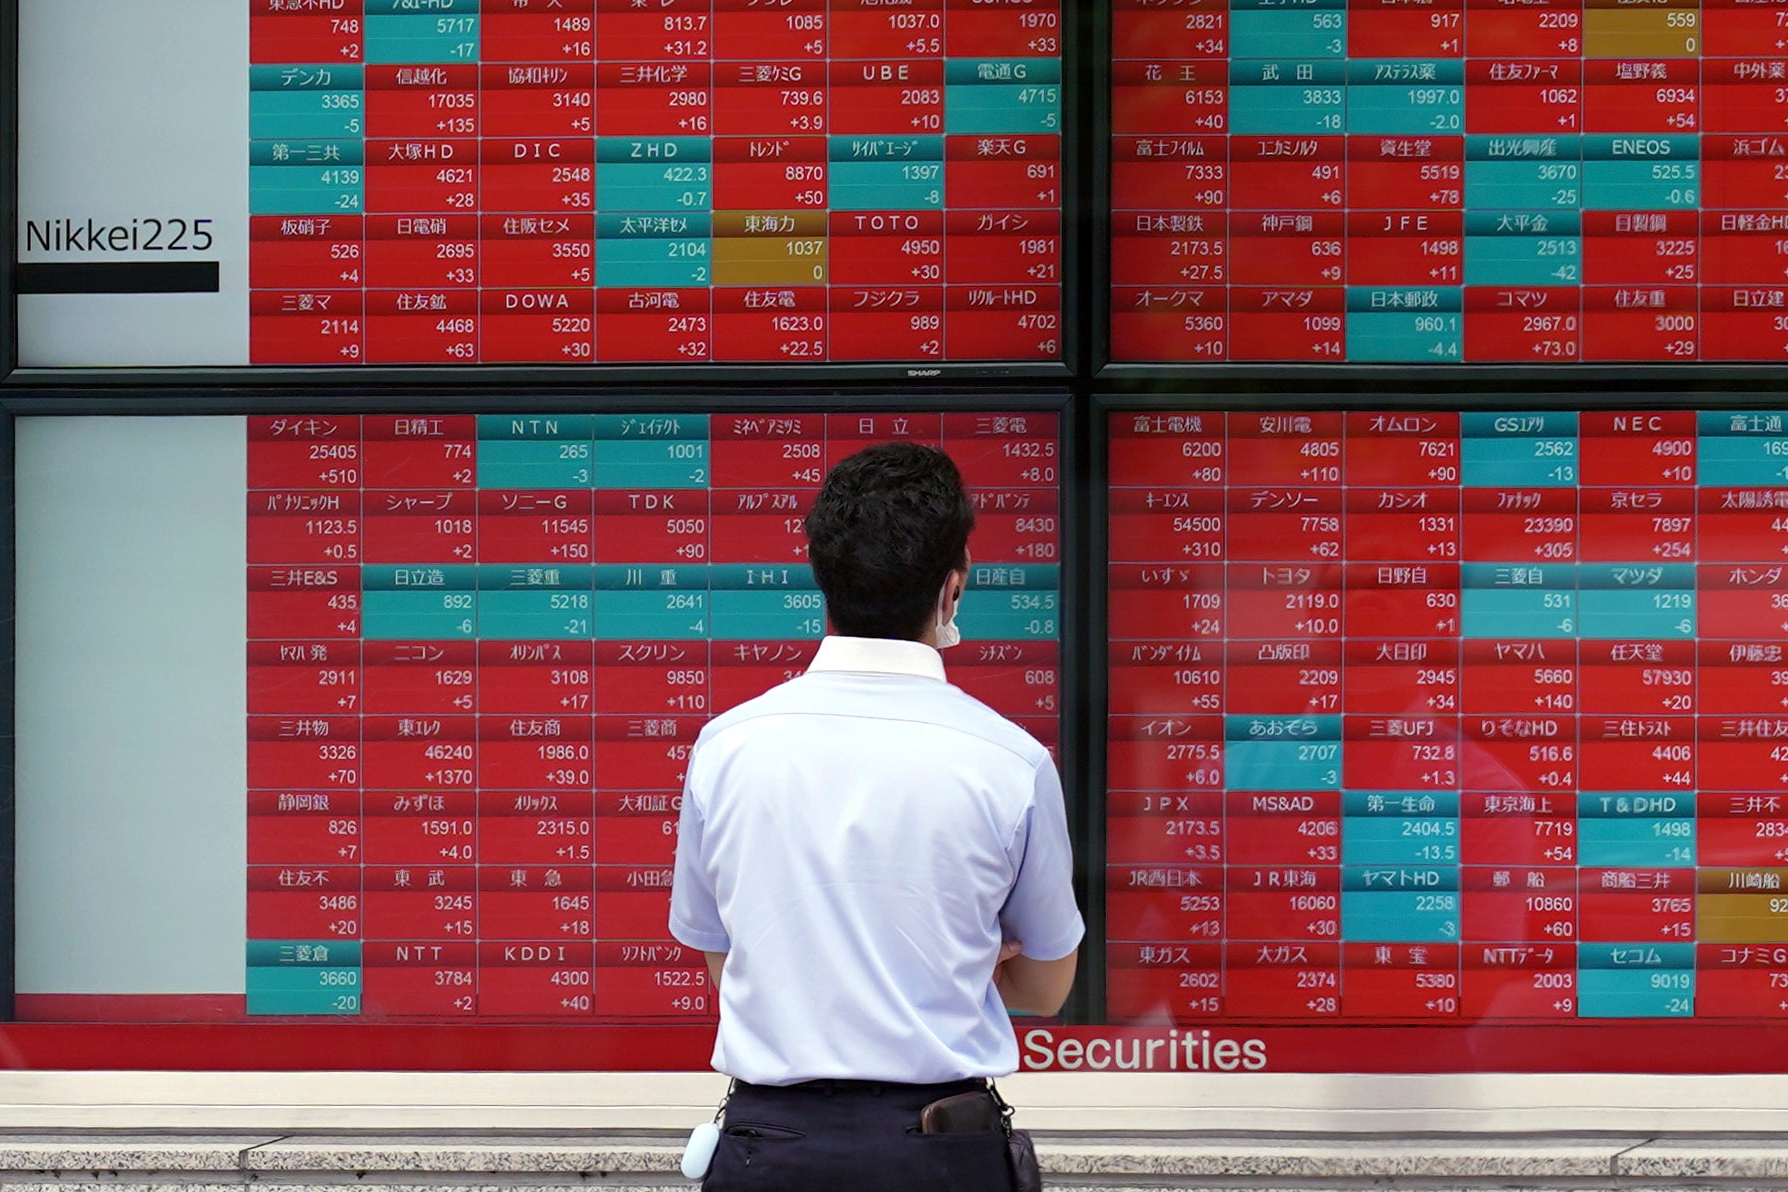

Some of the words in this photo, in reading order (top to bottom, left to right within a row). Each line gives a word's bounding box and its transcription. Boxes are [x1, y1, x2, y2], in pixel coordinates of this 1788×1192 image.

[281, 67, 331, 86] デンカ
[620, 64, 688, 83] 三井化学
[977, 63, 1027, 80] 電通G
[1615, 62, 1668, 80] 塩野義
[321, 94, 360, 109] 3365
[668, 91, 707, 106] 2980
[1018, 88, 1057, 104] 4715
[1656, 88, 1695, 103] 6934
[344, 118, 360, 134] -5
[678, 115, 707, 131] +16
[1040, 112, 1057, 128] -5
[1666, 112, 1696, 129] +54
[272, 143, 340, 161] 第一三共
[977, 138, 1026, 156] 楽天G
[1380, 139, 1432, 157] 資生堂
[1612, 139, 1671, 155] ENEOS
[320, 169, 360, 185] 4139
[1027, 164, 1054, 179] 691
[1420, 164, 1460, 180] 5519
[1652, 164, 1696, 180] 525.5
[334, 194, 359, 209] -24
[1036, 188, 1055, 203] +1
[1429, 189, 1460, 205] +78
[1665, 188, 1696, 205] -0.6
[280, 218, 332, 236] 板硝子
[503, 217, 570, 235] 住阪セメ
[977, 213, 1029, 231] ガイシ
[1137, 214, 1204, 232] 日本製鉄
[1261, 214, 1313, 232] 神戸鋼
[26, 216, 214, 252] Nikkei225
[330, 244, 360, 259] 526
[552, 242, 591, 258] 3550
[1019, 239, 1054, 255] 1981
[1170, 240, 1223, 256] 2173.5
[1311, 240, 1342, 256] 636
[339, 268, 359, 283] +4
[571, 267, 591, 282] +5
[1027, 263, 1054, 279] +21
[1179, 264, 1223, 280] +27.5
[1321, 265, 1342, 281] +9
[282, 293, 332, 311] 三菱マ
[396, 293, 447, 310] 住友鉱
[628, 291, 680, 309] 古河電
[854, 290, 920, 307] フジクラ
[1135, 290, 1204, 307] オークマ
[1262, 290, 1314, 307] アマダ
[1371, 290, 1438, 308] 日本郵政
[1498, 291, 1548, 308] コマツ
[320, 319, 359, 335] 2114
[435, 318, 475, 333] 4468
[668, 316, 707, 332] 2473
[910, 315, 940, 331] 989
[1184, 315, 1223, 331] 5360
[1303, 316, 1341, 331] 1099
[1414, 316, 1456, 332] 960.1
[1523, 315, 1577, 332] 2967.0
[339, 344, 360, 359] +9
[445, 342, 474, 358] +63
[677, 341, 706, 356] +32
[920, 339, 939, 355] +2
[1194, 340, 1223, 356] +10
[1311, 341, 1341, 356] +14
[1427, 341, 1458, 357] -4.4
[1532, 340, 1577, 356] +73.0
[270, 418, 338, 436] ダイキン
[1369, 415, 1437, 433] オムロン
[309, 444, 357, 460] 25405
[1419, 441, 1454, 457] 7621
[318, 469, 357, 484] +510
[1428, 466, 1456, 481] +90
[386, 492, 453, 511] シャープ
[502, 494, 567, 510] ソニーG
[1251, 490, 1318, 508] デンソー
[1378, 491, 1428, 508] カシオ
[1610, 491, 1663, 509] 京セラ
[434, 519, 473, 534] 1018
[541, 518, 588, 534] 11545
[1300, 516, 1340, 532] 7758
[1419, 516, 1454, 532] 1331
[1652, 517, 1692, 533] 7897
[452, 543, 473, 559] +2
[550, 543, 589, 559] +150
[1309, 541, 1339, 557] +62
[1427, 541, 1457, 557] +13
[1652, 541, 1692, 558] +254
[395, 568, 445, 586] 日立造
[510, 568, 560, 586] 三菱重
[1263, 567, 1311, 585] トヨタ
[443, 594, 473, 609] 892
[550, 594, 589, 609] 5218
[1285, 593, 1339, 609] 2119.0
[456, 618, 473, 634] -6
[563, 618, 587, 635] -21
[1294, 618, 1339, 634] +10.0
[394, 645, 444, 661] ニコン
[1610, 643, 1663, 661] 任天堂
[435, 670, 473, 685] 1629
[1642, 669, 1692, 686] 57930
[452, 694, 473, 710] +5
[1662, 694, 1692, 710] +20
[280, 719, 329, 737] 三井物
[509, 718, 561, 737] 住友商
[1140, 718, 1192, 736] イオン
[1371, 719, 1434, 736] 三菱UFJ
[319, 745, 357, 760] 3326
[538, 744, 589, 760] 1986.0
[1167, 744, 1220, 761] 2775.5
[1412, 744, 1455, 761] 732.8
[328, 769, 357, 784] +70
[546, 769, 589, 785] +39.0
[1186, 768, 1220, 786] +6.0
[1420, 770, 1456, 786] +1.3
[278, 793, 330, 811] 静岡銀
[393, 793, 445, 812] みずほ
[1252, 796, 1314, 811] MS&AD
[1484, 795, 1552, 813] 東京海上
[328, 819, 357, 835] 826
[421, 820, 473, 835] 1591.0
[1297, 820, 1339, 836] 4206
[1534, 821, 1573, 837] 7719
[337, 844, 357, 860] +7
[439, 844, 473, 860] +4.0
[1307, 845, 1338, 861] +33
[1543, 846, 1573, 861] +54
[278, 869, 329, 887] 住友不
[319, 895, 357, 910] 3486
[328, 919, 357, 935] +20
[505, 946, 565, 961] KDDI
[1139, 946, 1190, 964] 東ガス
[1257, 945, 1308, 963] 大ガス
[1610, 947, 1662, 964] セコム
[550, 970, 589, 986] 4300
[1179, 972, 1219, 988] 2602
[1297, 971, 1336, 988] 2374
[1650, 973, 1690, 989] 9019
[560, 995, 590, 1011] +40
[1189, 997, 1219, 1012] +15
[1306, 997, 1337, 1012] +28
[1665, 998, 1690, 1013] -24
[1023, 1029, 1267, 1072] Securities
